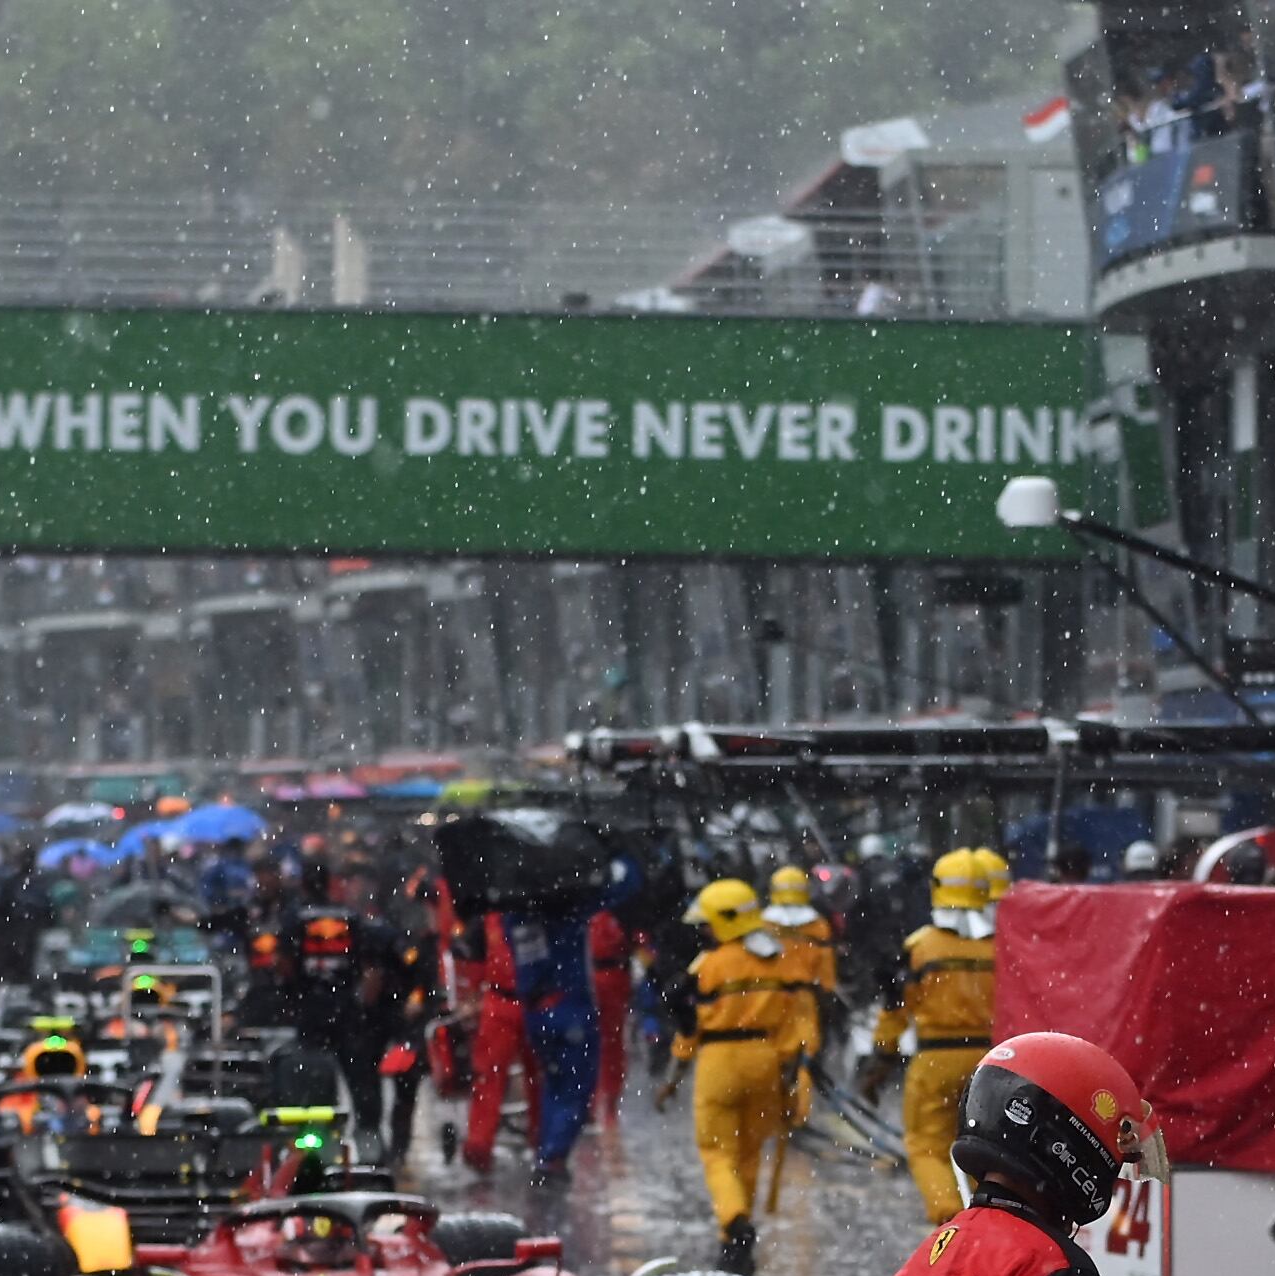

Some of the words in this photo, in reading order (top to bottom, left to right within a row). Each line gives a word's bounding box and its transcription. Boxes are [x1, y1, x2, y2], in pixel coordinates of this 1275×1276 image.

[225, 393, 379, 456] YOU
[404, 398, 610, 458] DRIVE
[632, 402, 857, 462] NEVER
[1068, 1116, 1100, 1150] RICHARD
[1097, 1145, 1117, 1168] MILLE
[1107, 1178, 1150, 1259] 24
